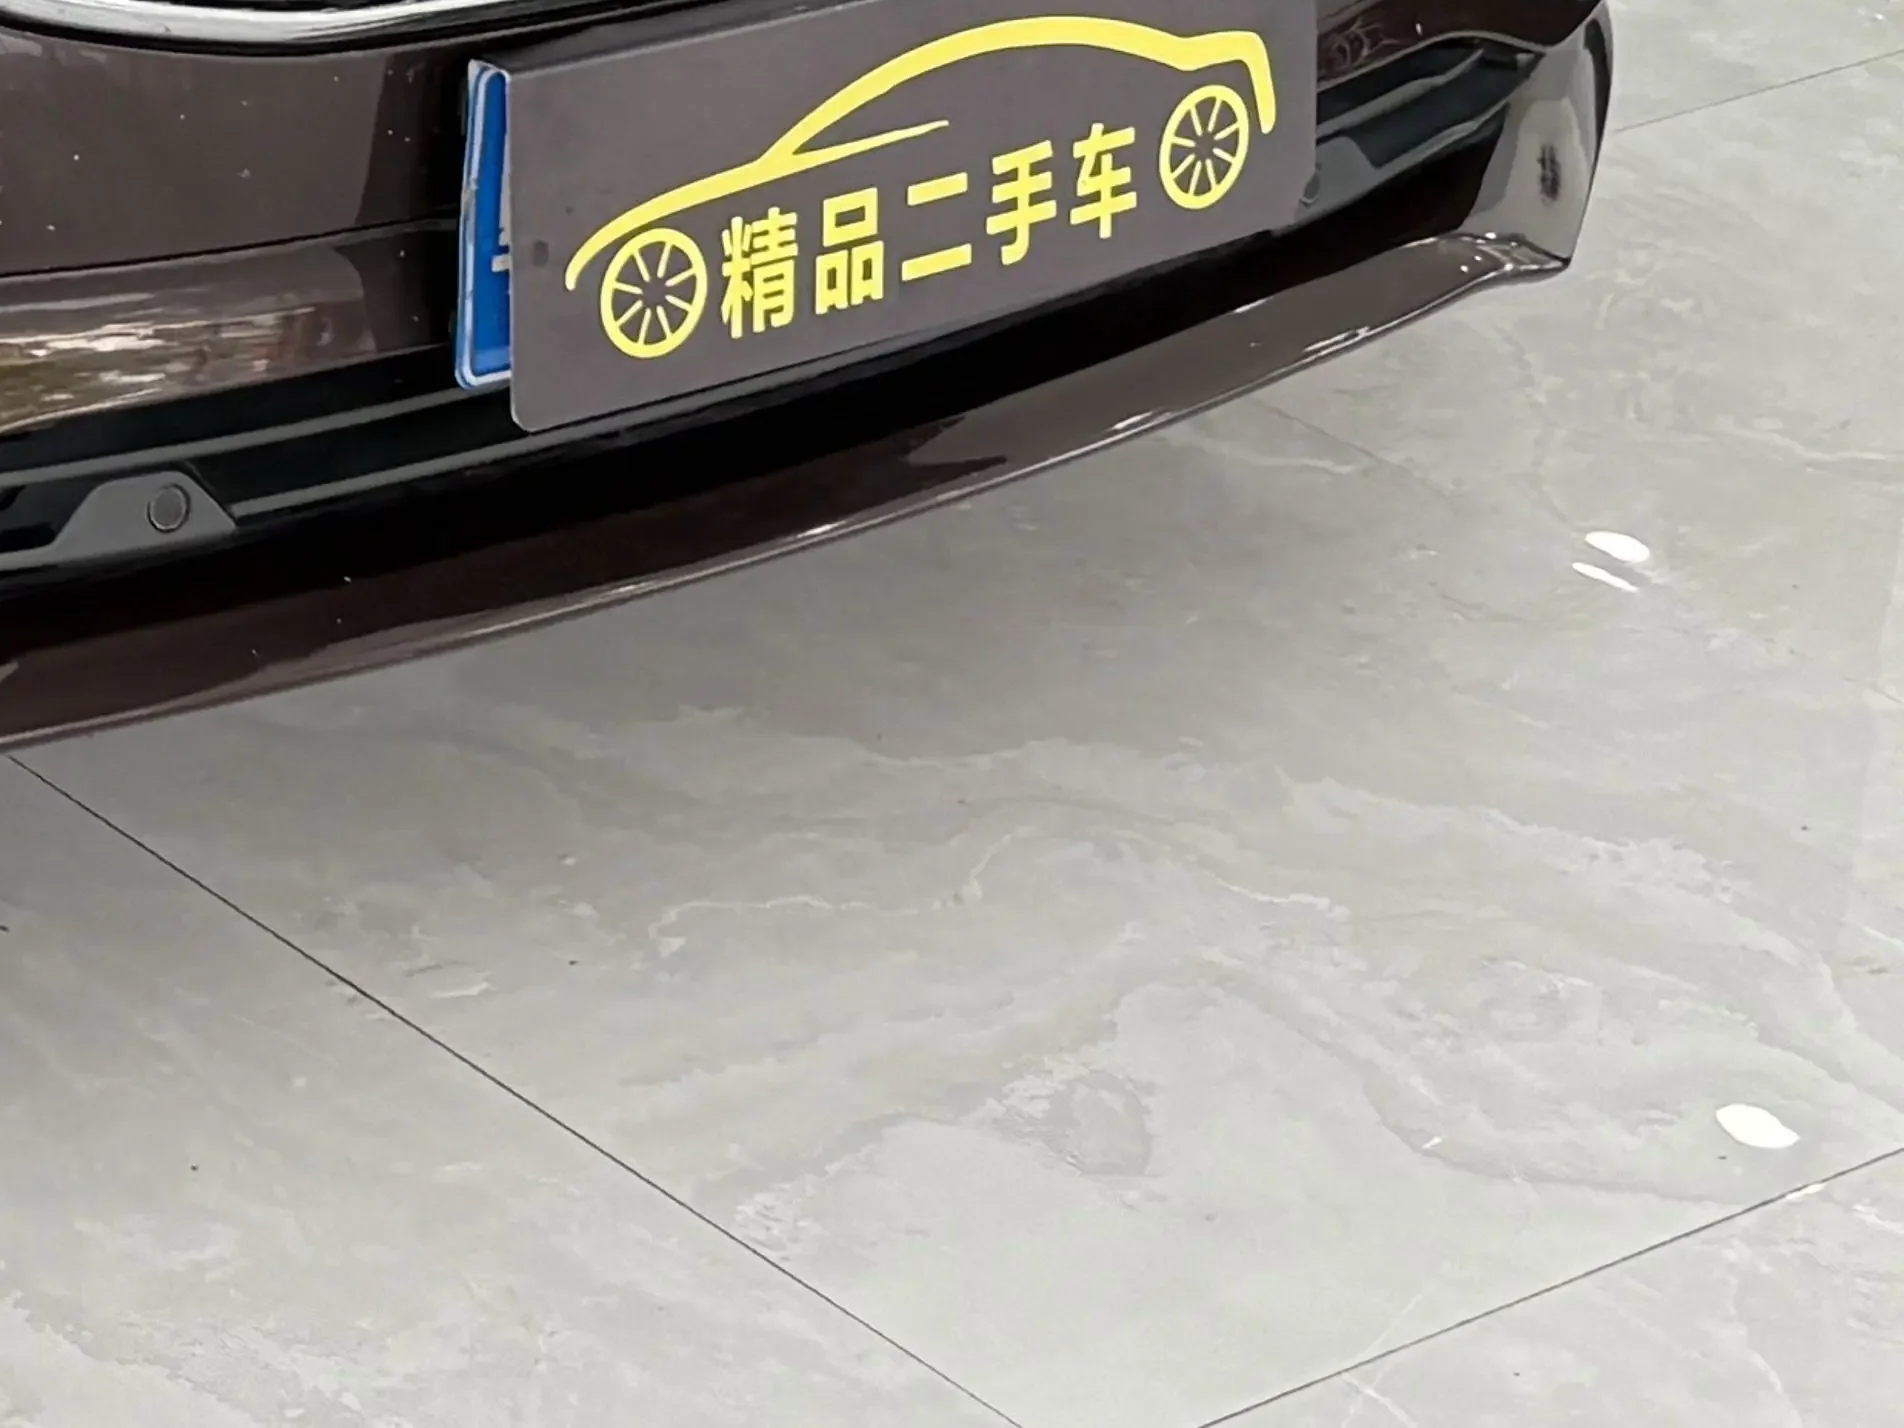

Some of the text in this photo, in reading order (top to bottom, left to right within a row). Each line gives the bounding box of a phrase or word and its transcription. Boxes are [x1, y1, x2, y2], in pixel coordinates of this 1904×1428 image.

[719, 121, 1138, 340] 精品二手车
